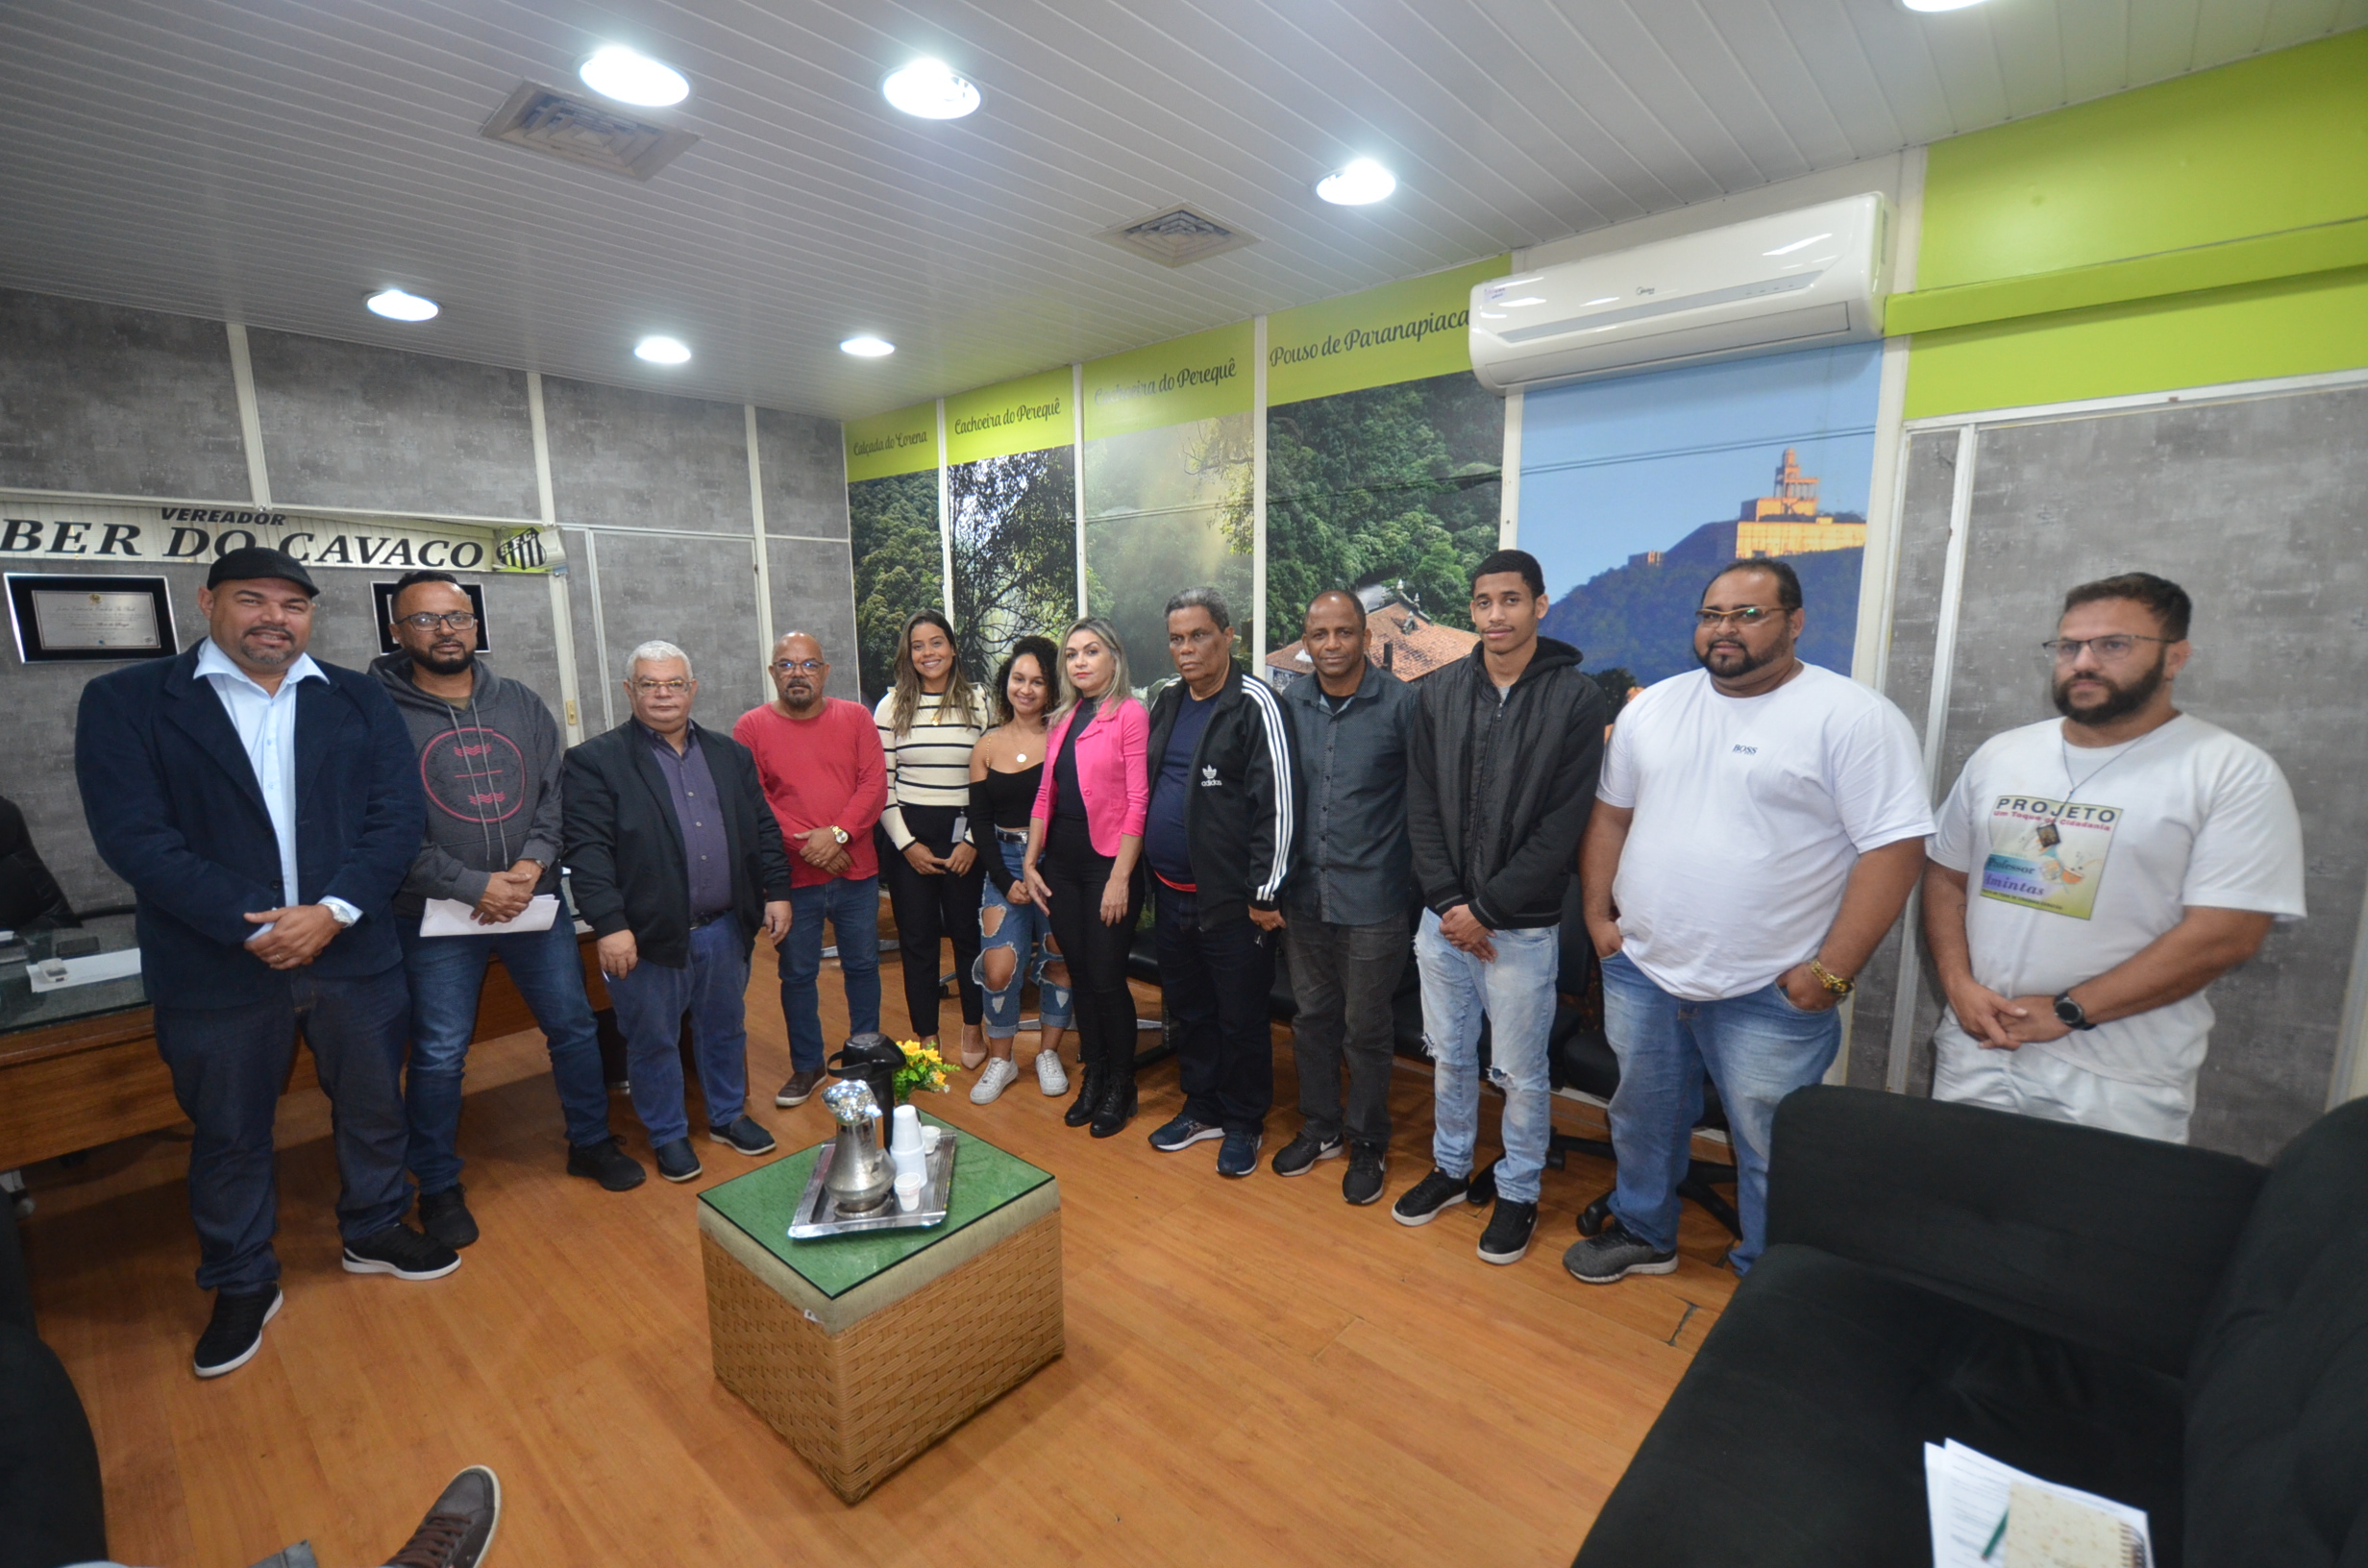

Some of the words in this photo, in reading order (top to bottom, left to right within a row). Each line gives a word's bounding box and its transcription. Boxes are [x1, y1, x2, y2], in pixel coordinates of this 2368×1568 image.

[1270, 344, 1319, 367] Pouso
[1321, 335, 1342, 356] de
[1344, 308, 1469, 351] Paranapiaca
[1095, 380, 1157, 406] Cachoeira
[1158, 373, 1175, 393] do
[1176, 357, 1237, 387] Perequê
[954, 410, 1002, 435] Cachoeira
[1002, 407, 1015, 425] do
[1016, 398, 1061, 422] Perequê
[853, 436, 884, 456] Calçada
[884, 434, 895, 449] do
[895, 431, 927, 449] Lorena
[161, 507, 286, 527] VEREADOR
[0, 518, 142, 556] BER
[162, 527, 257, 557] DO
[278, 532, 483, 569] CAVACO
[1732, 744, 1758, 755] BOSS
[1996, 798, 2116, 823] PROJETO
[2011, 811, 2041, 821] Toque
[2060, 819, 2111, 832] Cidadania
